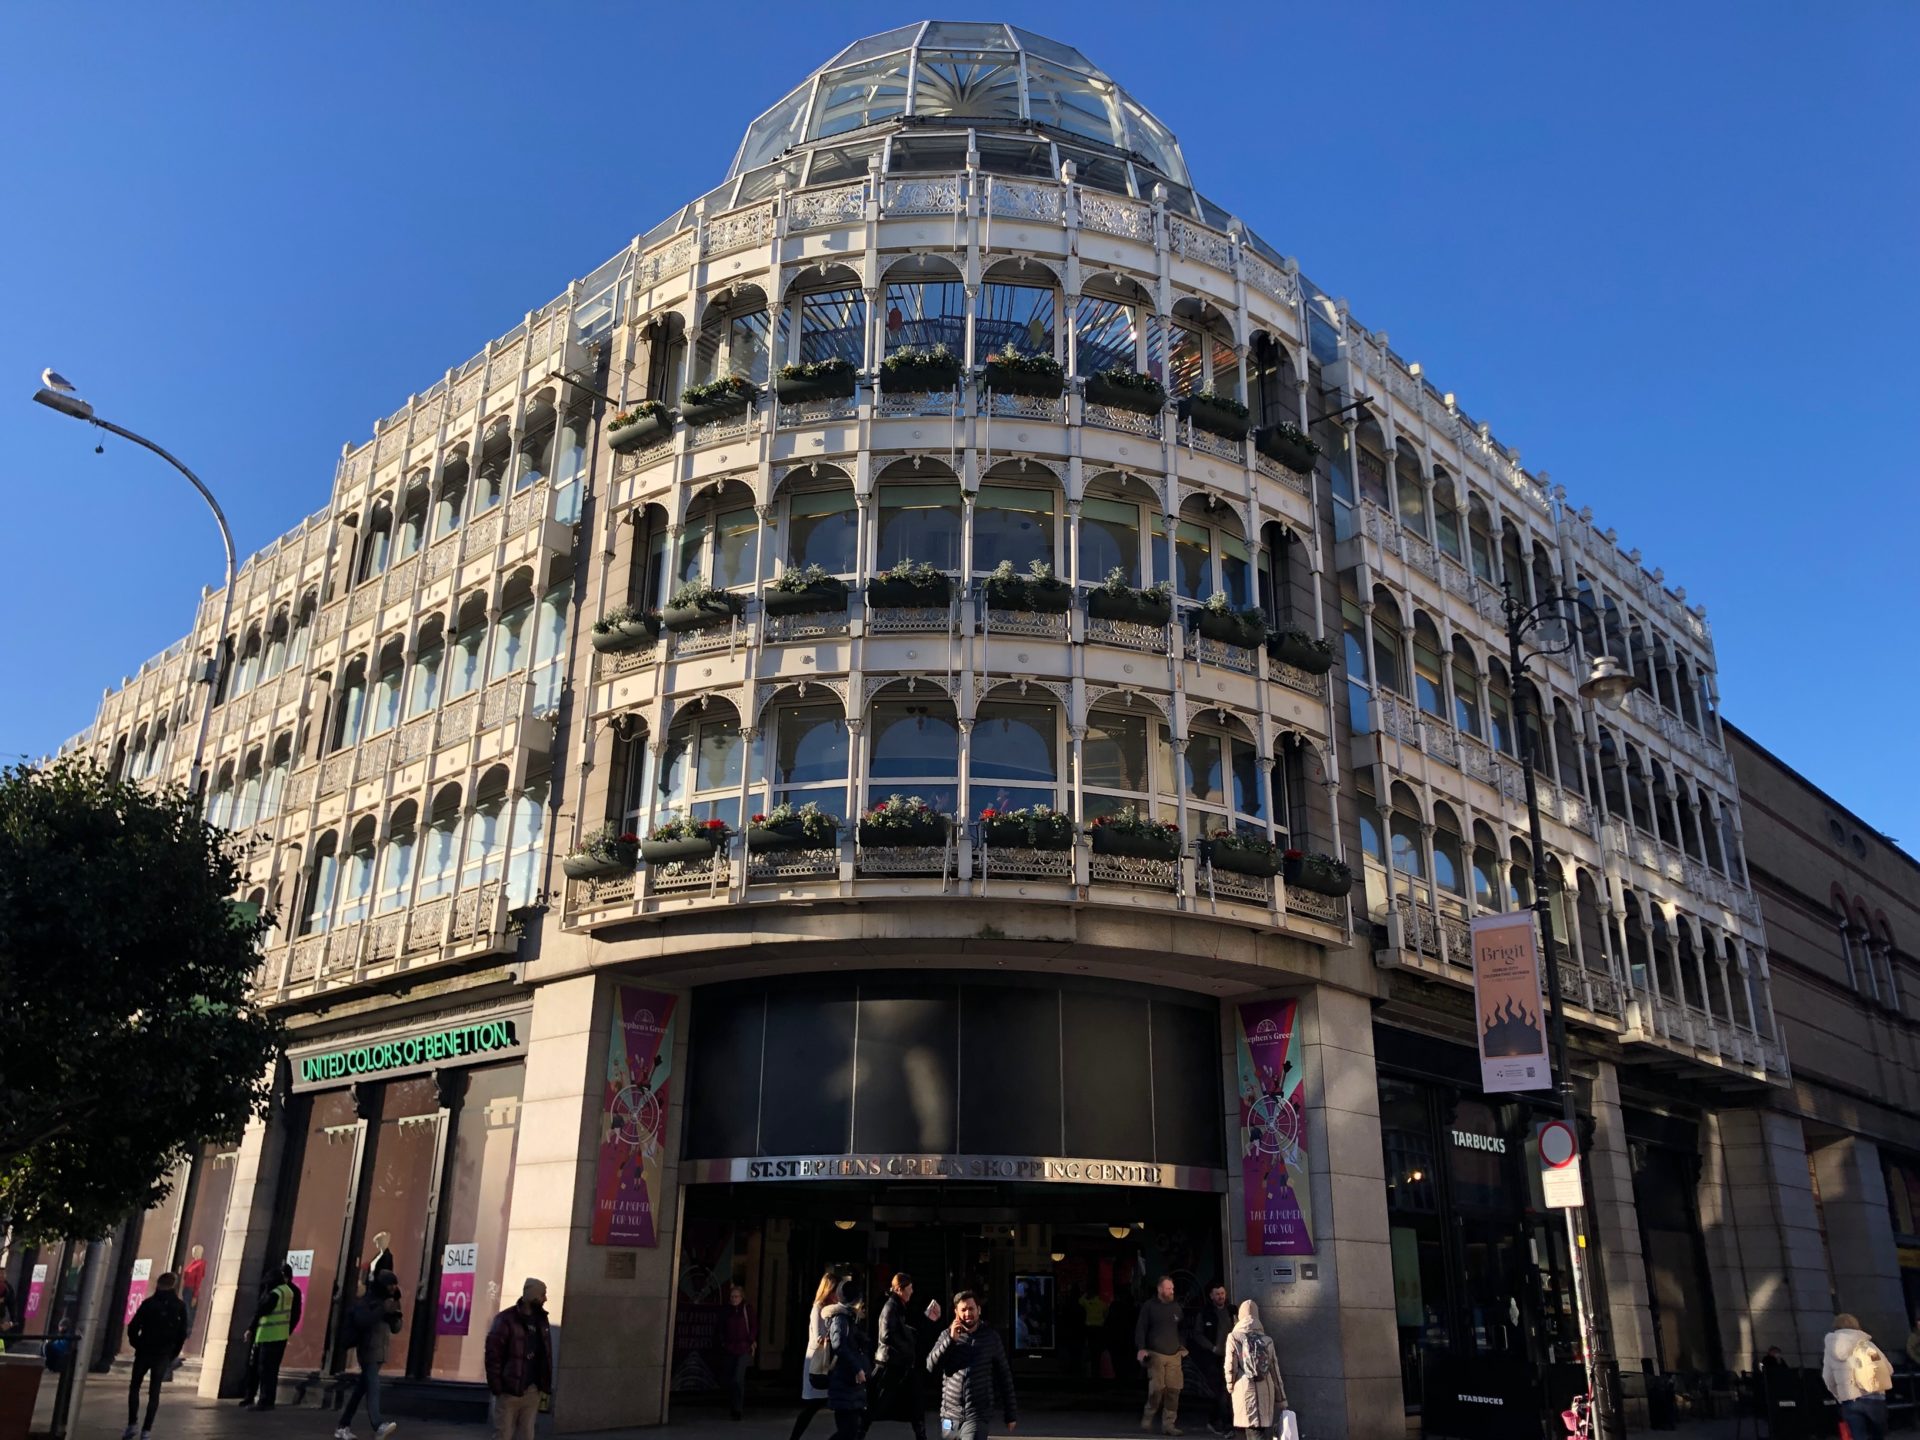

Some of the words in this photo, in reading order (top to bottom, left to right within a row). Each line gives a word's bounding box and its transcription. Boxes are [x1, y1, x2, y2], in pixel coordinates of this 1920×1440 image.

[1481, 944, 1525, 966] Brigit
[302, 1052, 345, 1081] UNITED
[347, 1043, 402, 1073] COLORS
[404, 1039, 424, 1064] OF
[887, 1158, 963, 1176] GREEN
[970, 1159, 1080, 1179] SHOPPING
[1085, 1163, 1162, 1184] CENTRE
[1250, 1210, 1267, 1221] TAKE
[1264, 1223, 1278, 1234] FOR
[1280, 1223, 1294, 1234] YOU
[289, 1254, 311, 1271] SALE
[447, 1248, 475, 1267] SALE
[1458, 1394, 1504, 1406] STARBUCKS
